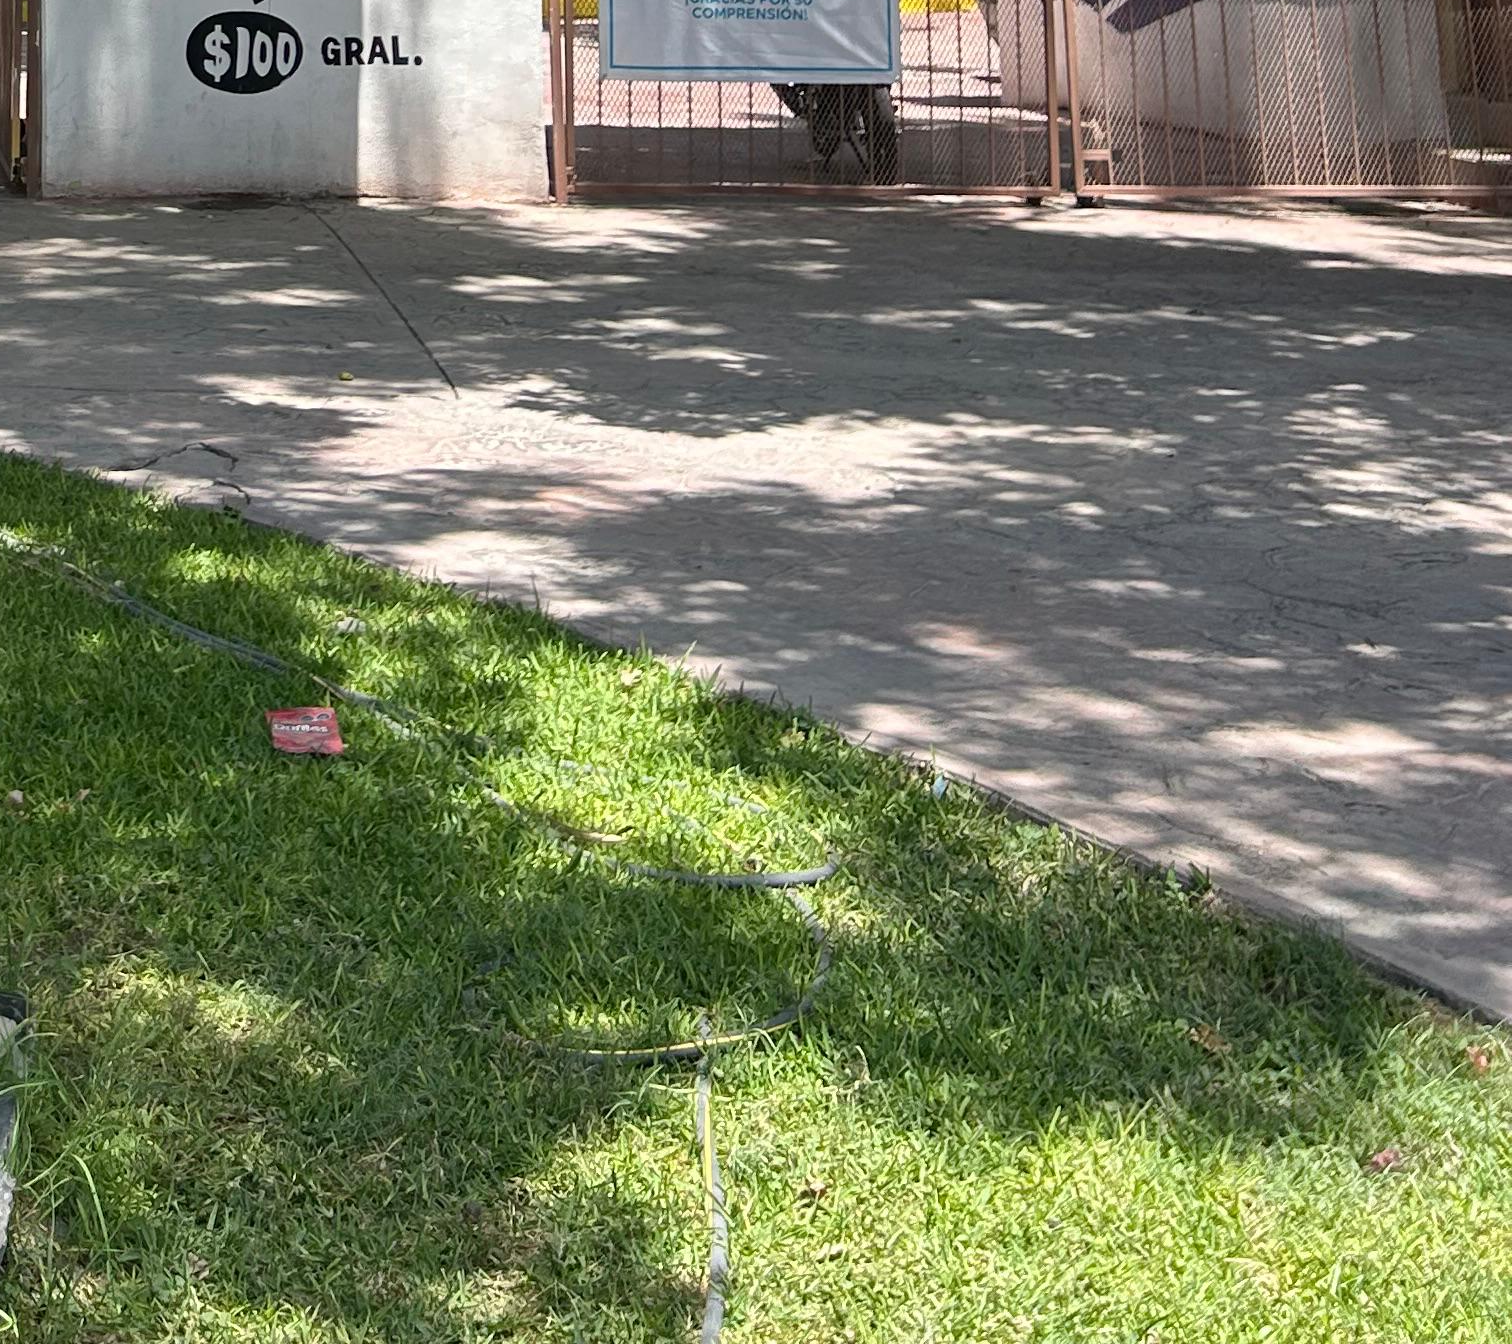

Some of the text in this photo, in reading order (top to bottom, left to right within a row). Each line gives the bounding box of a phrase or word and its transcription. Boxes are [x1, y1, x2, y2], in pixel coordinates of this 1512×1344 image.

[692, 6, 808, 21] COMPRENSIÓN!
[203, 24, 423, 83] $100 GRAL.
